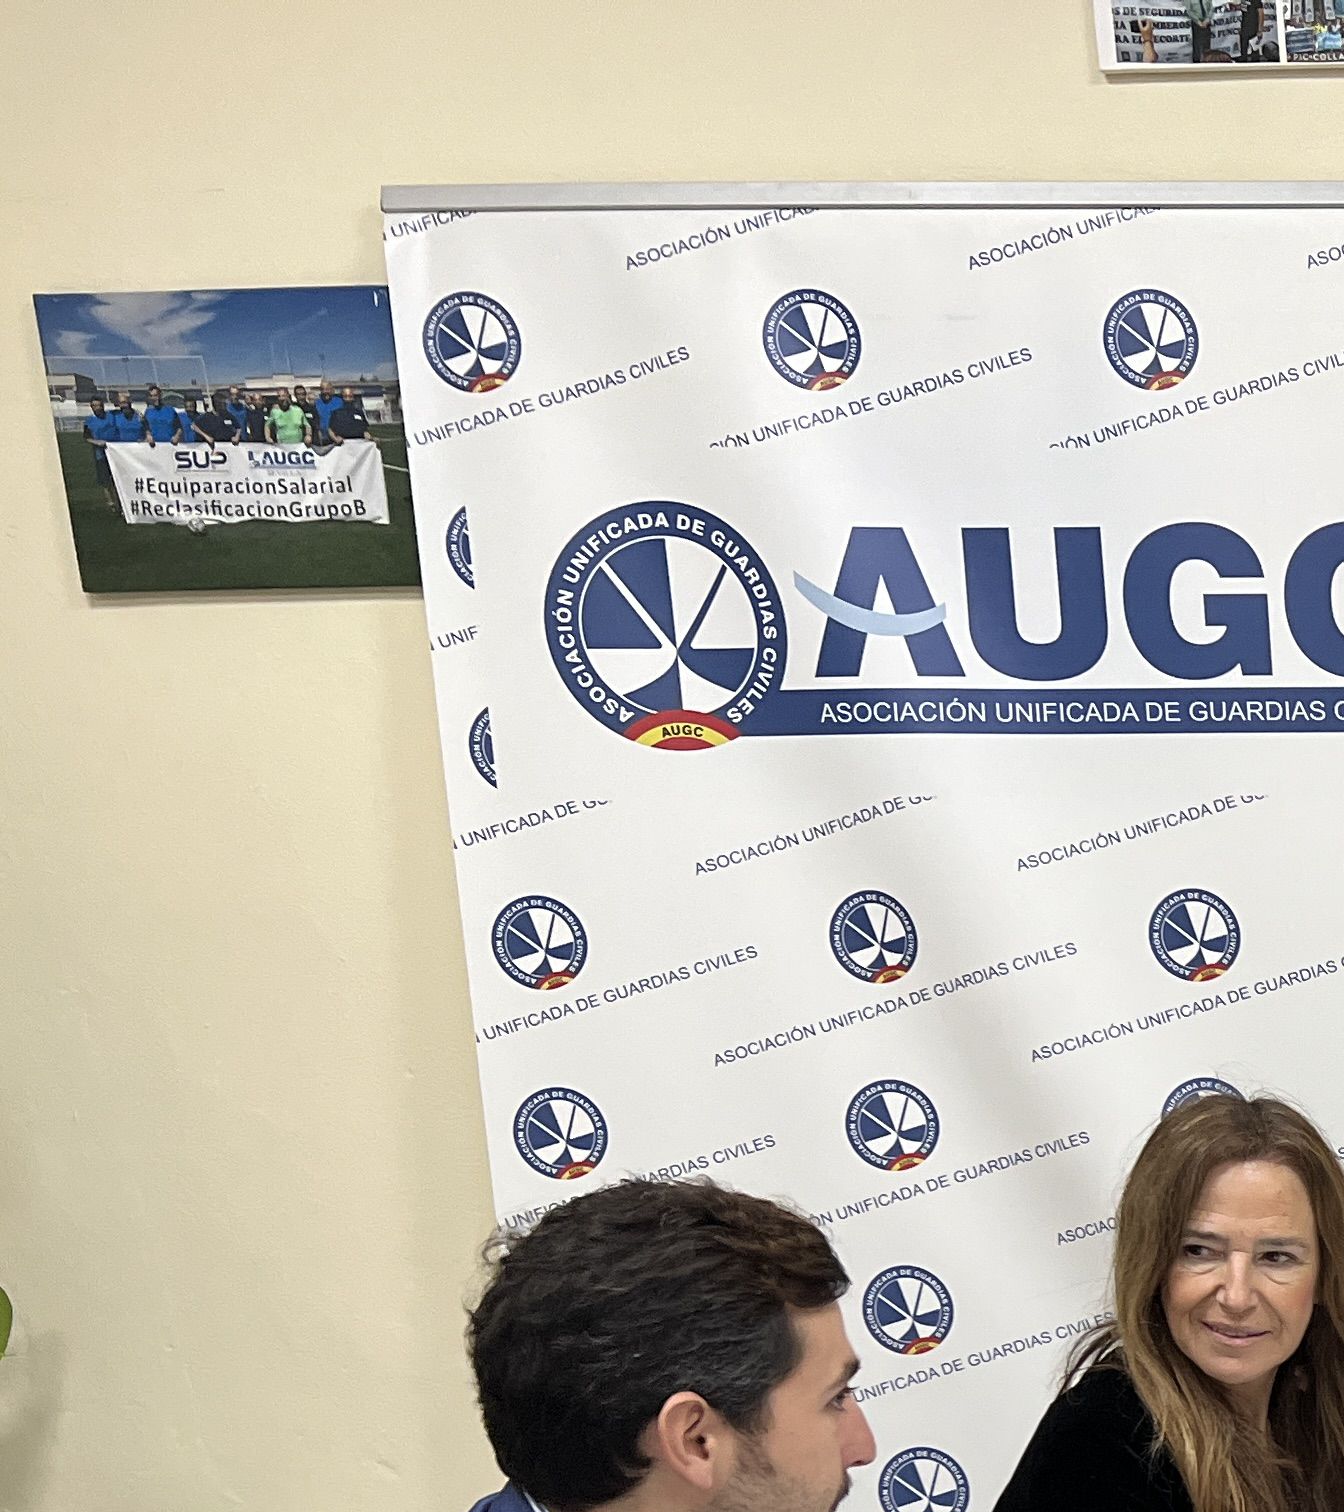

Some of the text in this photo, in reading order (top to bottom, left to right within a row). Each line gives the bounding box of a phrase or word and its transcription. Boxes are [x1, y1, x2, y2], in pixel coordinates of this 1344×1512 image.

[626, 224, 732, 271] ASOCIACIÓN
[969, 224, 1074, 271] ASOCIACIÓN
[413, 346, 690, 446] UNIFICADA DE GUARDIAS CIVILES
[751, 405, 849, 443] UNIFICADA
[847, 396, 875, 416] DE
[876, 368, 965, 407] GUARDIAS
[967, 347, 1033, 379] CIVILES
[1092, 404, 1185, 444] UNIFICADA
[1184, 395, 1211, 415] DE
[1212, 367, 1300, 406] GUARDIAS
[134, 475, 353, 498] #EquiparacionSalarial
[174, 451, 228, 469] SUP
[131, 500, 366, 519] #ReclasificacionGrupoB
[676, 514, 706, 536] DE
[563, 511, 670, 584] UNIFICADA
[710, 530, 778, 640] GUARDIAS
[726, 647, 778, 723] CIVILES
[820, 697, 986, 723] ASOCIACIÓN
[995, 700, 1139, 723] UNIFICADA
[1146, 701, 1181, 722] DE
[1189, 700, 1326, 722] GUARDIAS
[661, 724, 705, 738] AUGC
[459, 800, 581, 847] UNIFICADA DE
[695, 795, 907, 877] ASOCIACIÓN UNIFICADA DE
[1017, 795, 1238, 872] ASOCIACIÓN UNIFICADA DE
[482, 945, 758, 1040] UNIFICADA DE GUARDIAS CIVILES
[714, 942, 1078, 1068] ASOCIACIÓN UNIFICADA DE GUARDIAS CIVILES
[1031, 1021, 1134, 1063] ASOCIACIÓN
[1135, 994, 1227, 1031] UNIFICADA
[1226, 985, 1252, 1004] DE
[1253, 959, 1338, 996] GUARDIAS
[712, 1134, 776, 1164] CIVILES
[835, 1131, 1090, 1220] UNIFICADA DE GUARDIAS CIVILES
[853, 1367, 941, 1403] UNIFICADA
[940, 1357, 966, 1376] DE
[967, 1331, 1053, 1367] GUARDIAS
